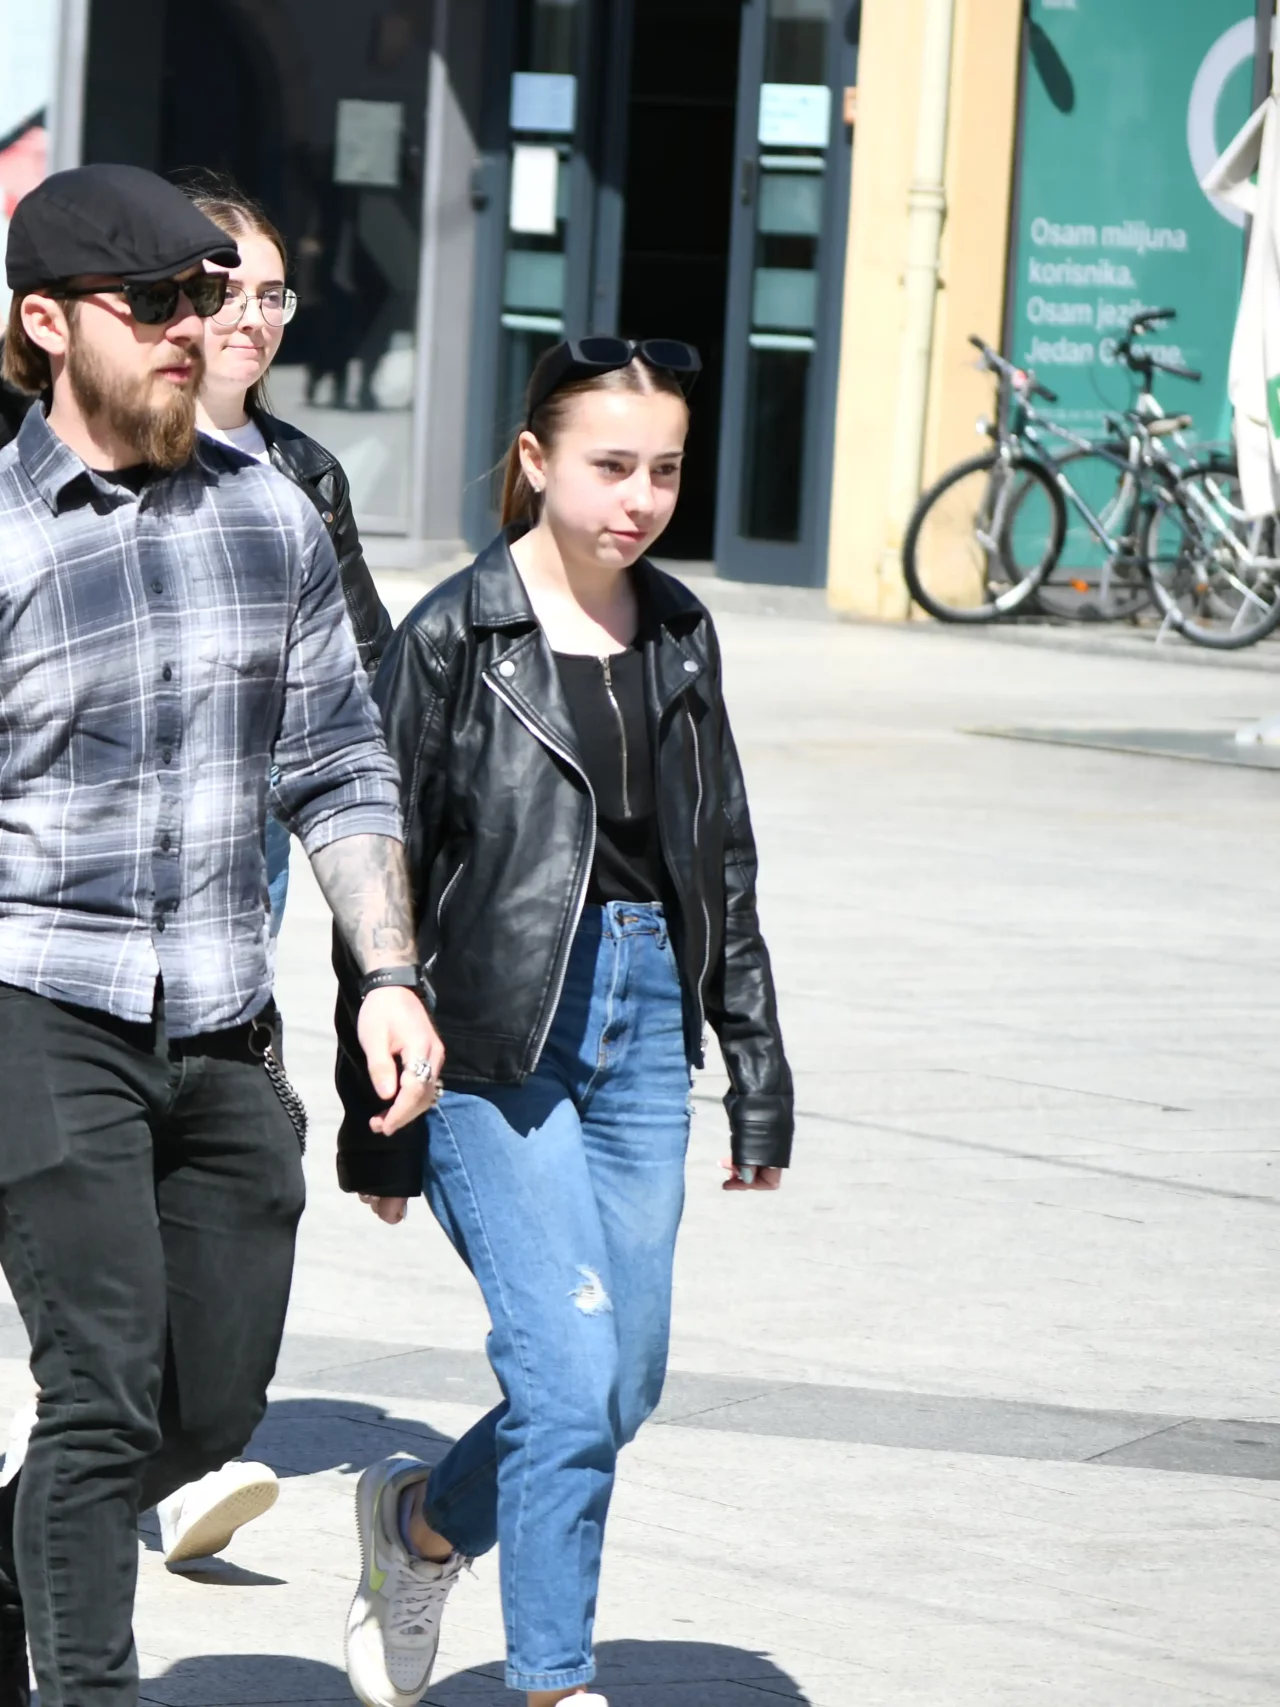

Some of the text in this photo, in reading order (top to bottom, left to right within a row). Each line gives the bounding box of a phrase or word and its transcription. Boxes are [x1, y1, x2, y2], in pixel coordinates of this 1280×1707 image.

[1030, 217, 1188, 256] Osam milijuna
[1028, 256, 1136, 288] korisnika.
[1026, 295, 1094, 325] Osam
[1024, 336, 1094, 364] Jedan
